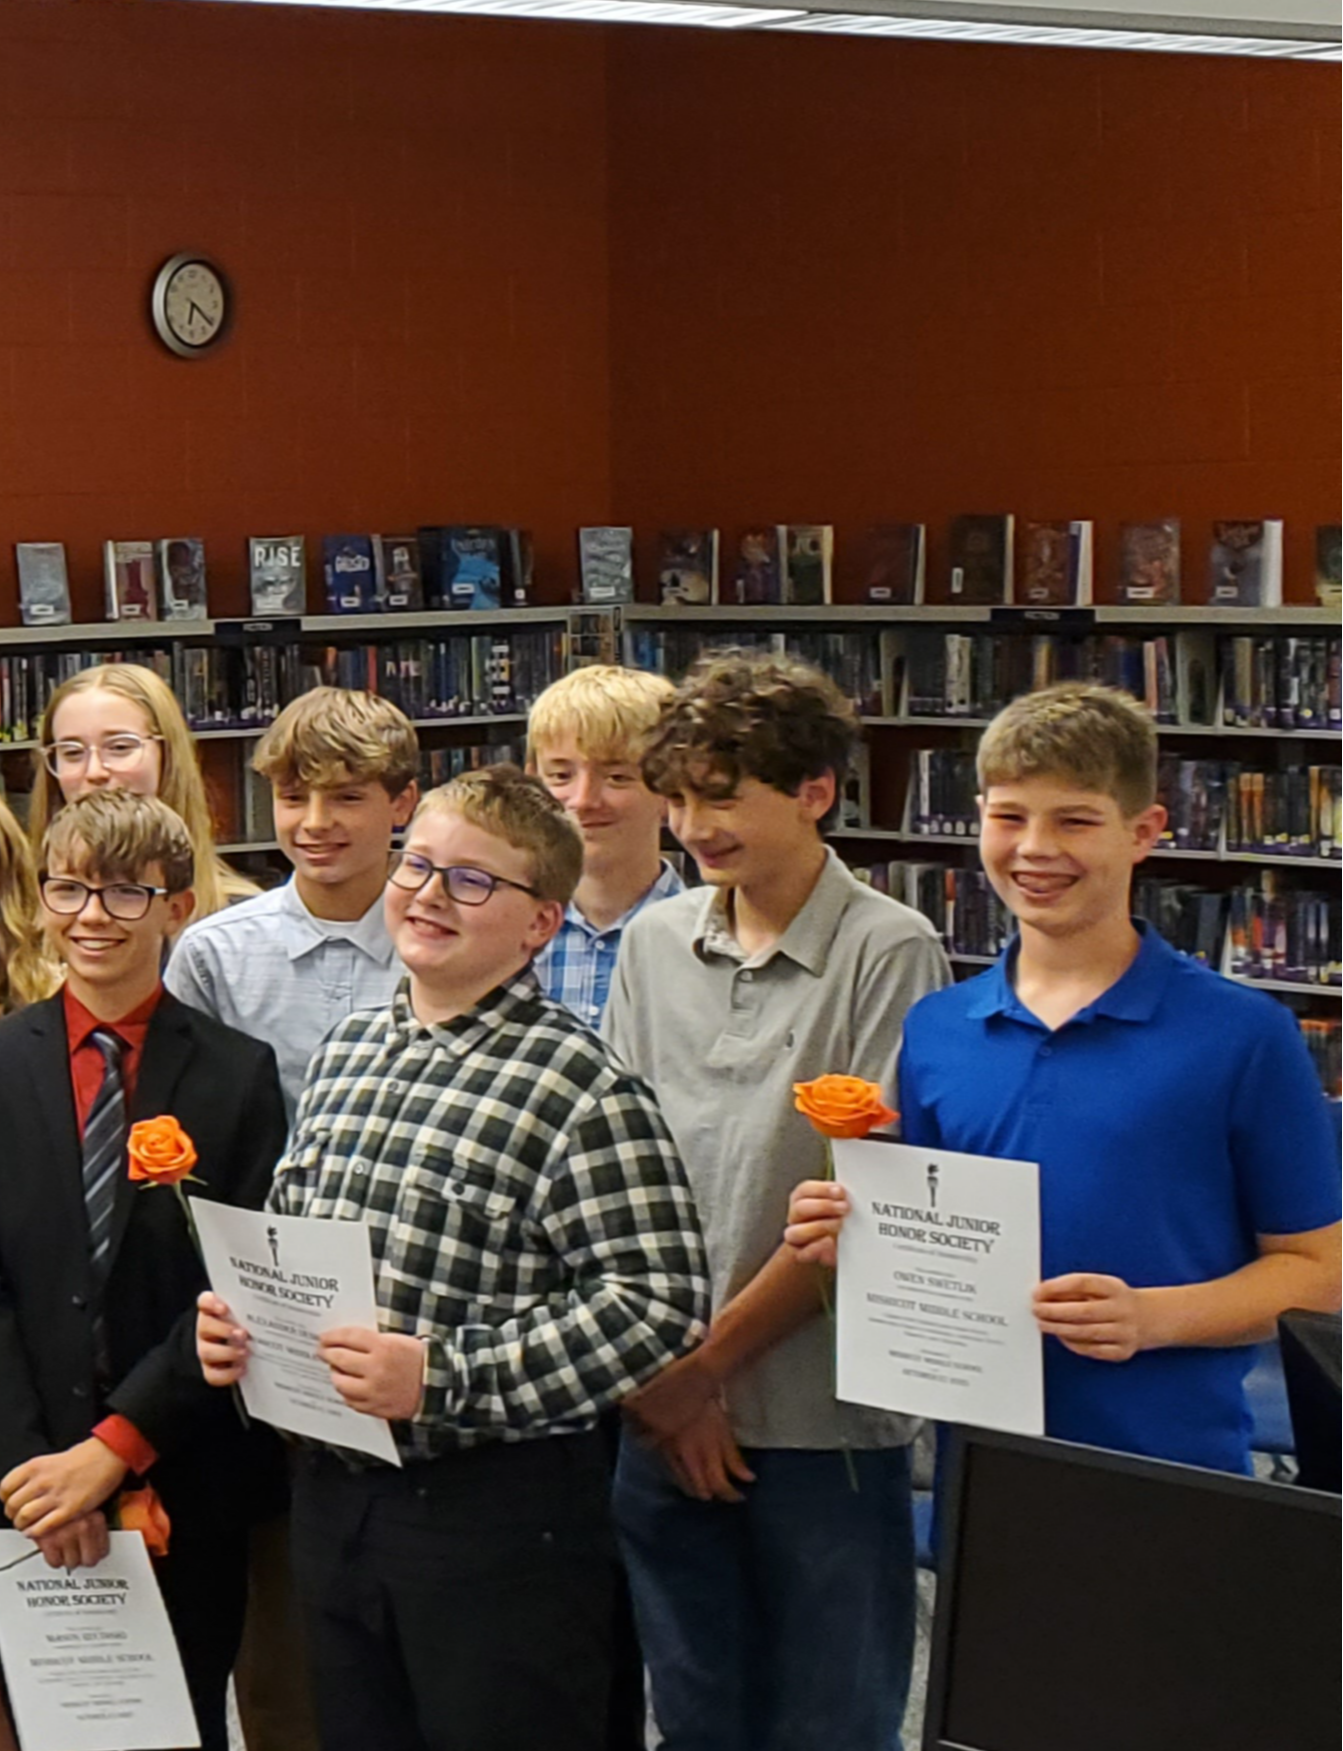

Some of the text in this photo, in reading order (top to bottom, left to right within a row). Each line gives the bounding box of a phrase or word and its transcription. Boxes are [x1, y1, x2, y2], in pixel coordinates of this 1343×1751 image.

[254, 546, 301, 568] RISE
[872, 1202, 1001, 1235] NATIONAL JUNIOR
[878, 1222, 926, 1242] HONOR
[929, 1233, 994, 1254] SOCIETY
[17, 1579, 129, 1591] NATIONAL JUNIOR
[27, 1593, 126, 1607] HONOR SOCIETY
